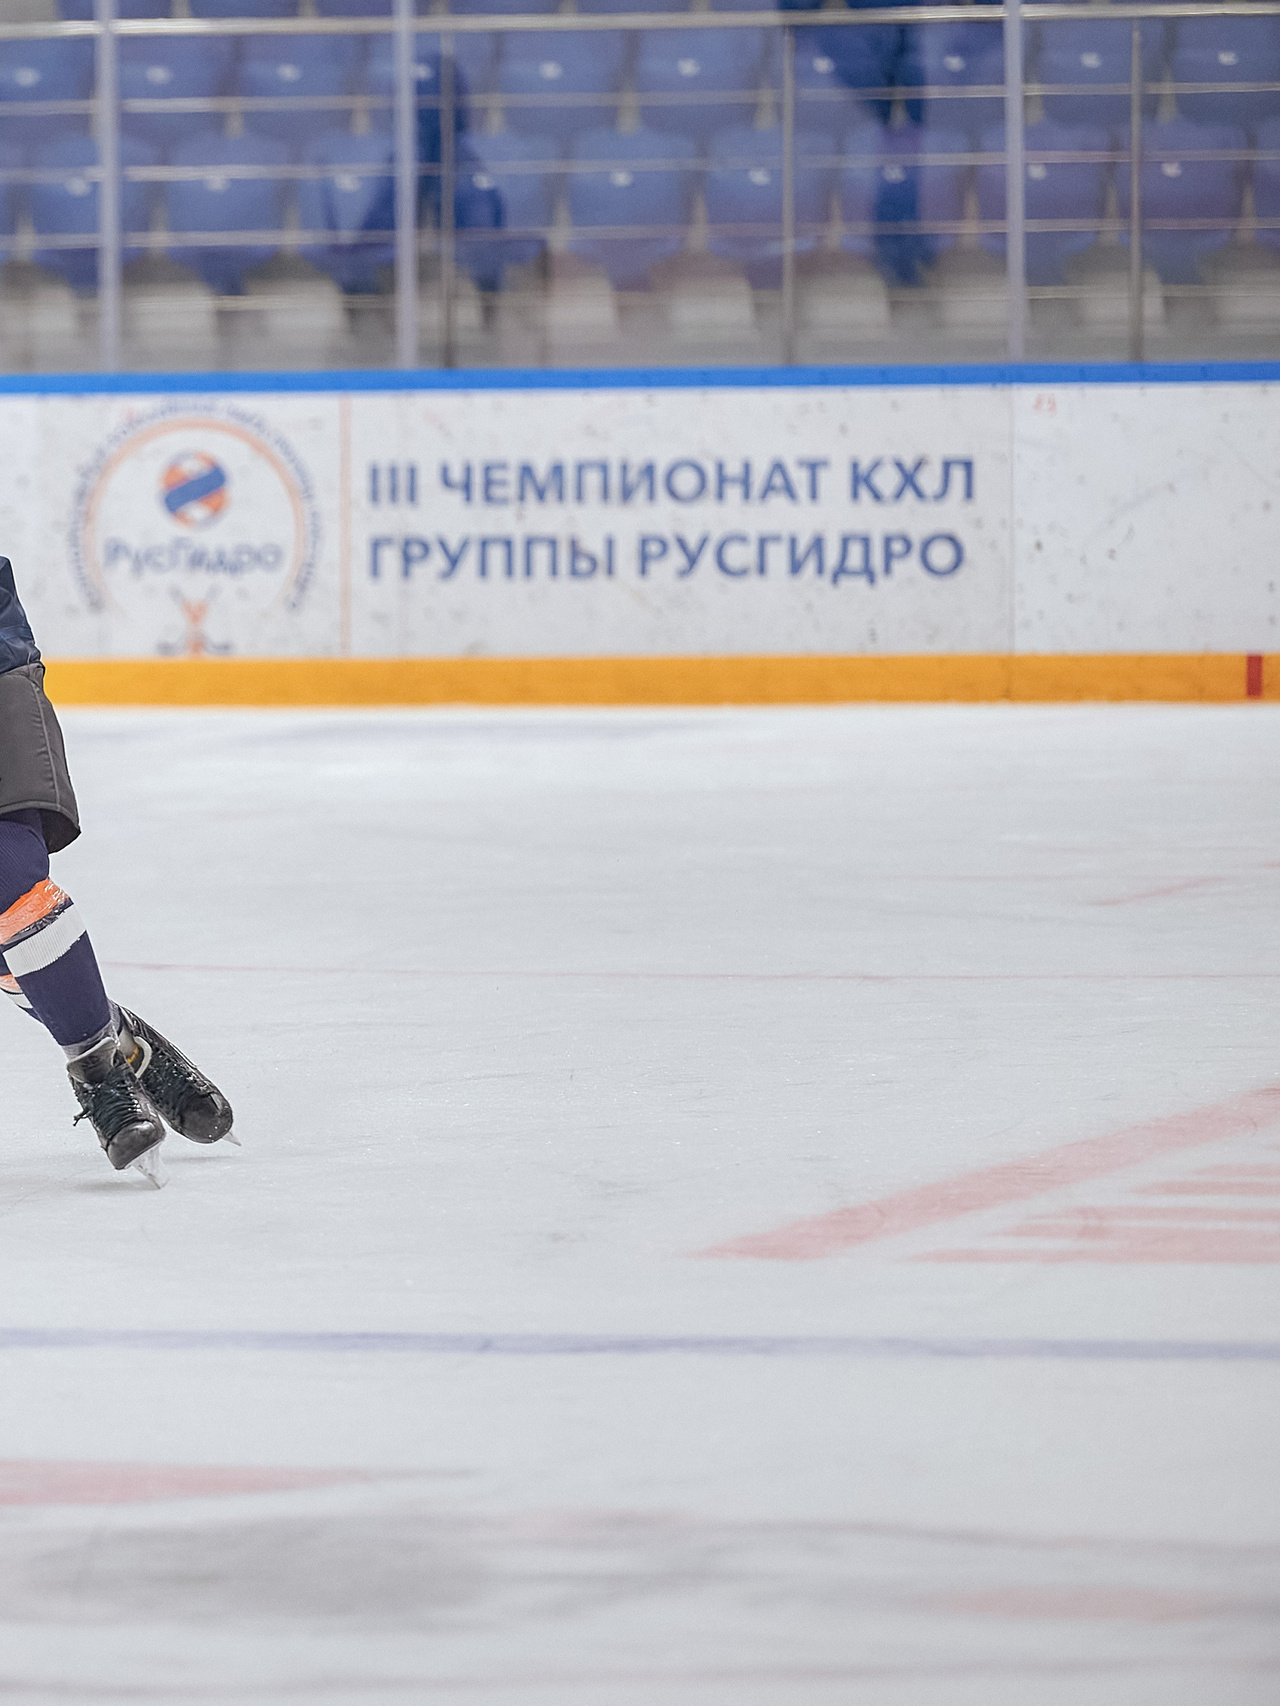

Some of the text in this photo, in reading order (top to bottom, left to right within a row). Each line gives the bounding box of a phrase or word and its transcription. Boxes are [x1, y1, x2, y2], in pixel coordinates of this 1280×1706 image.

[368, 458, 975, 505] III ЧЕМПИОНАТ КХЛ
[369, 532, 966, 586] ГРУППЫ РУСГИДРО
